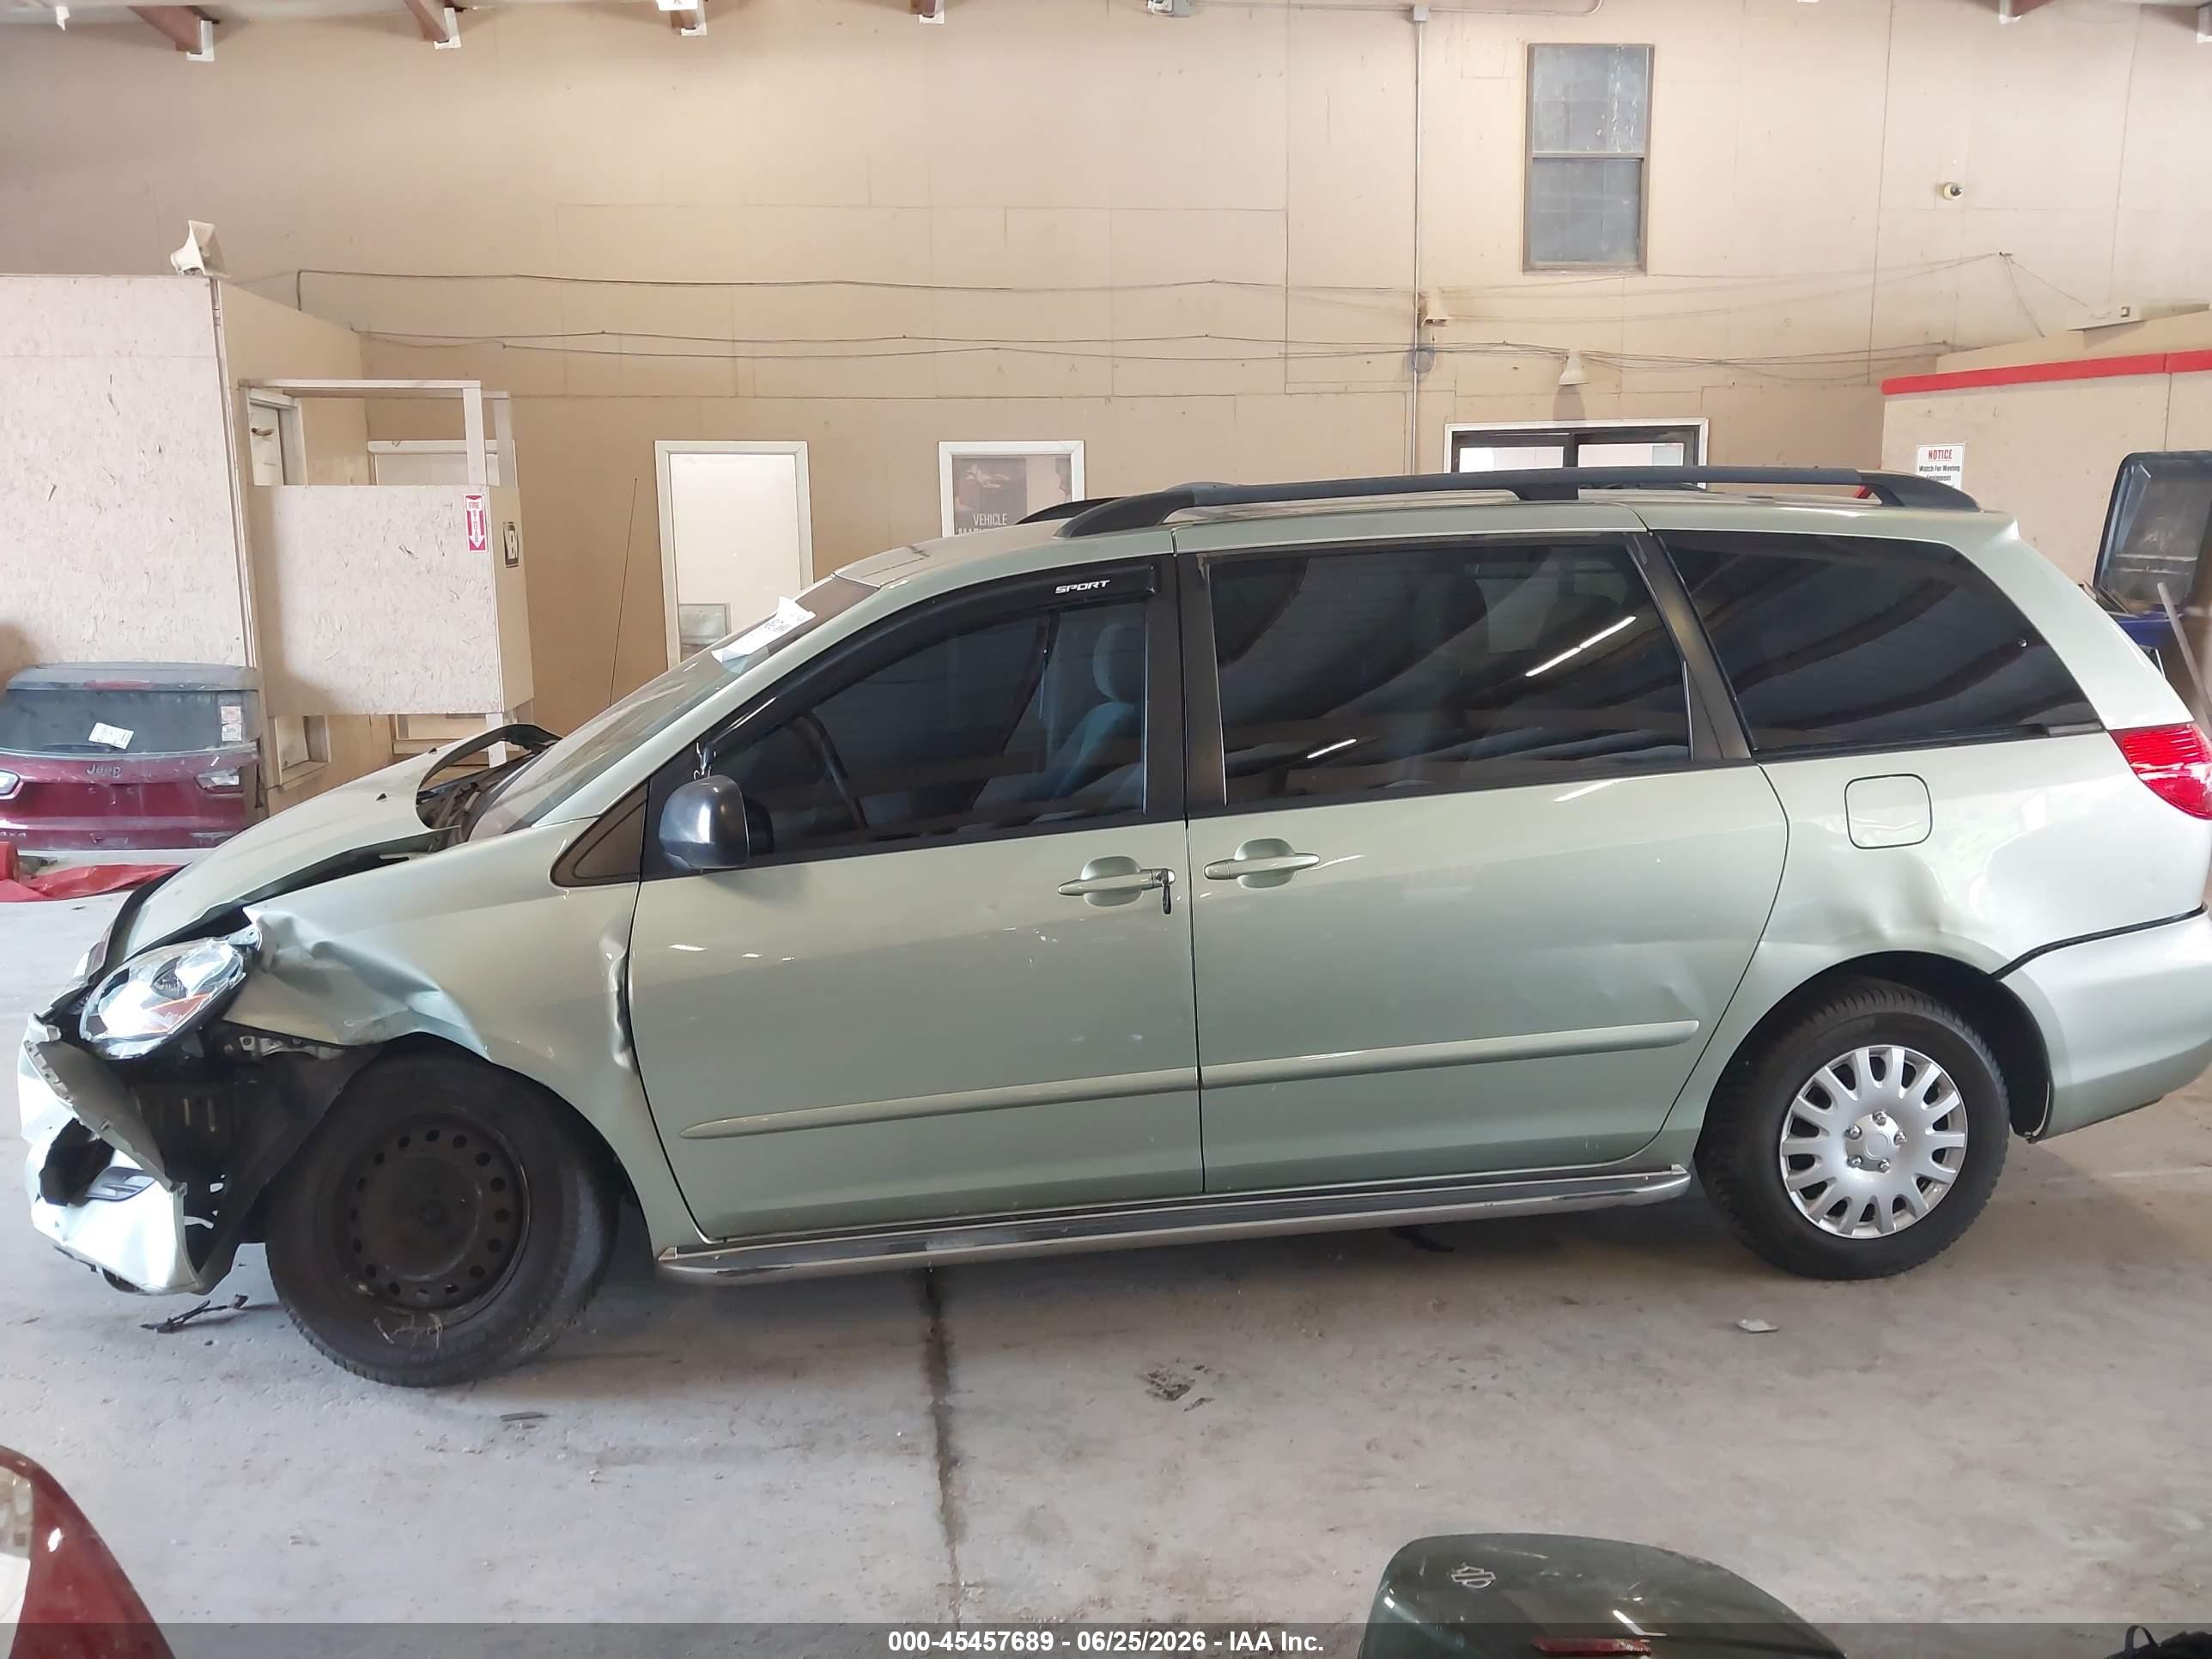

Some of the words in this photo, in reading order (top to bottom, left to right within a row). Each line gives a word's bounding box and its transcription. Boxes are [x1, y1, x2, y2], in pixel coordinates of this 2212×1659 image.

[1928, 449, 1953, 460] NOTICE
[972, 514, 1008, 526] VEHICLE
[1054, 579, 1110, 594] SPORT
[86, 763, 121, 778] Jeep
